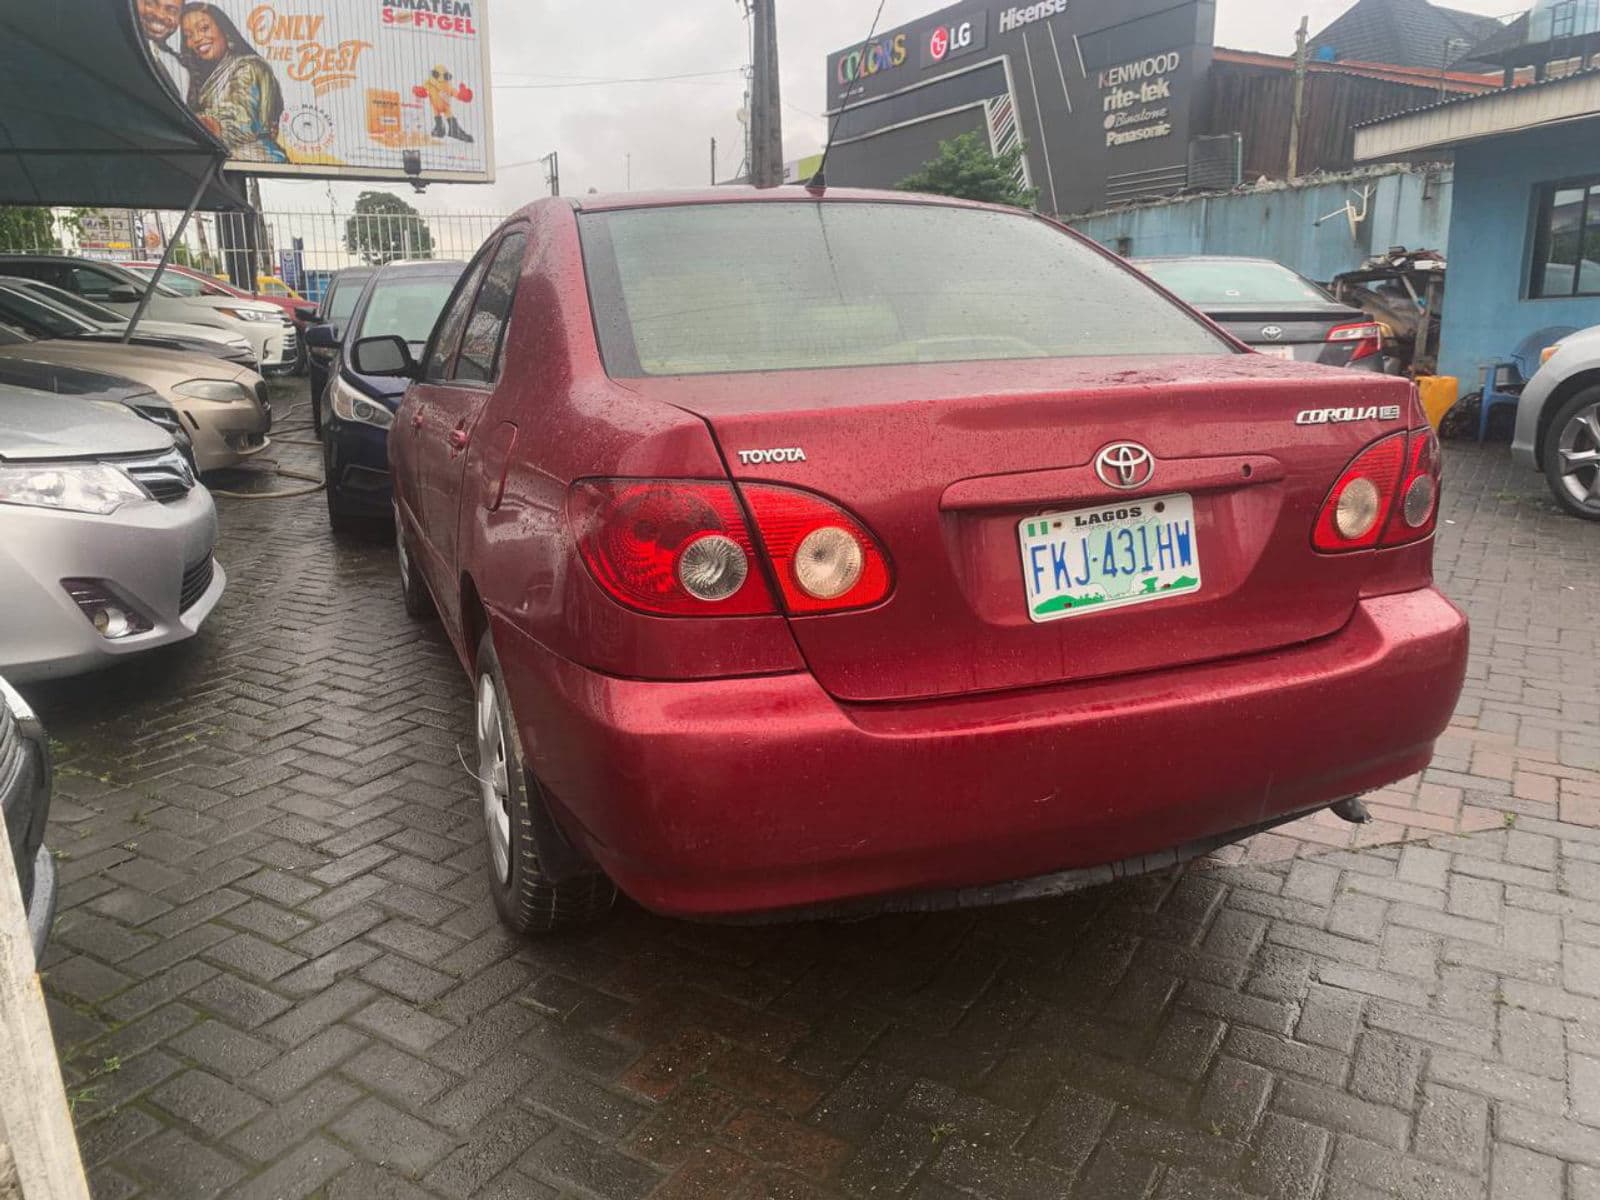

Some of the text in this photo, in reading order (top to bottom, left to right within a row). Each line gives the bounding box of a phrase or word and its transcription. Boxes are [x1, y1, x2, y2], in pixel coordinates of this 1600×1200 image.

[247, 4, 325, 46] ONLY
[1000, 0, 1067, 33] Hisense
[950, 22, 971, 50] LG
[265, 39, 374, 81] THE BEST
[1099, 52, 1179, 89] KENWOOD
[1103, 78, 1170, 113] rite-tek
[1105, 120, 1171, 147] Panasonic
[1295, 406, 1378, 425] COROLLA
[738, 447, 807, 464] TOYOTA
[1074, 506, 1143, 527] LAGOS
[1030, 519, 1192, 594] FKJ-431HW
